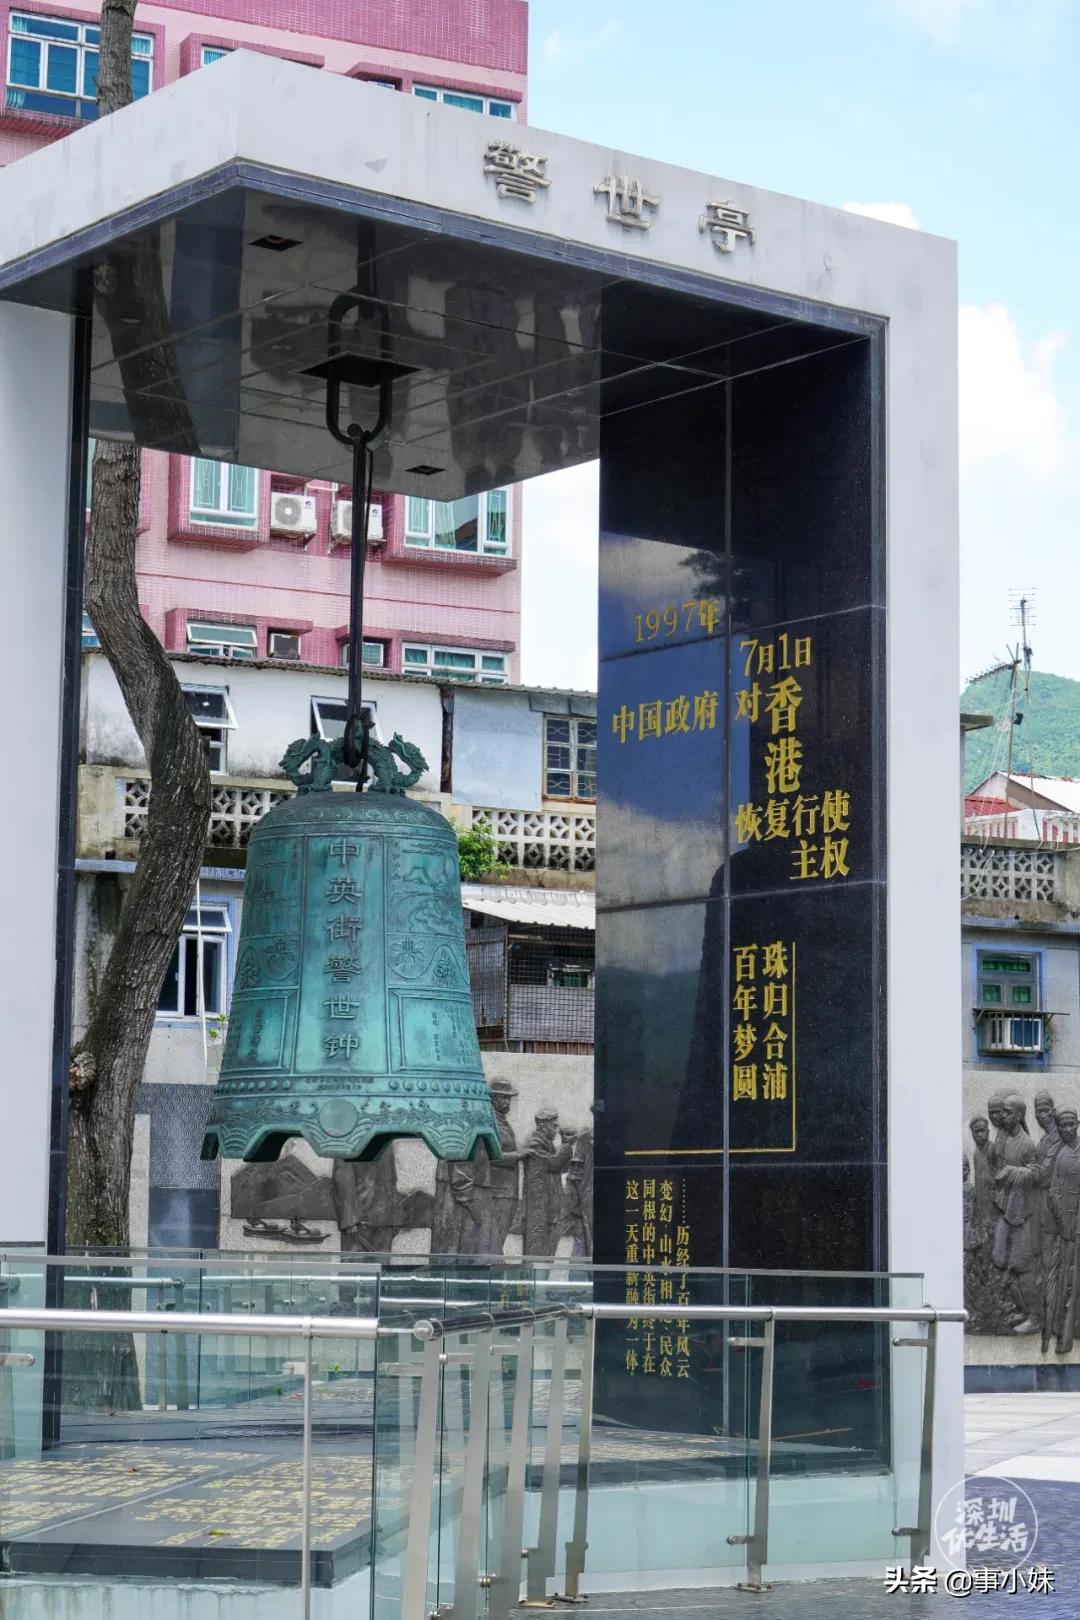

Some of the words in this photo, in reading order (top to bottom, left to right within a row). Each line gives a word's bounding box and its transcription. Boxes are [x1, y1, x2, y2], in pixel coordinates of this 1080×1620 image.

[484, 140, 756, 254] 警世亭
[635, 600, 720, 642] 1997年
[740, 632, 812, 677] 7月1日
[612, 690, 719, 744] 中国政府
[765, 676, 803, 794] 香港
[736, 789, 850, 844] 恢复行使
[790, 836, 850, 880] 主权
[323, 839, 364, 1060] 中英街警世钟
[733, 943, 758, 1101] 百年梦圆
[762, 941, 788, 1100] 珠归合浦
